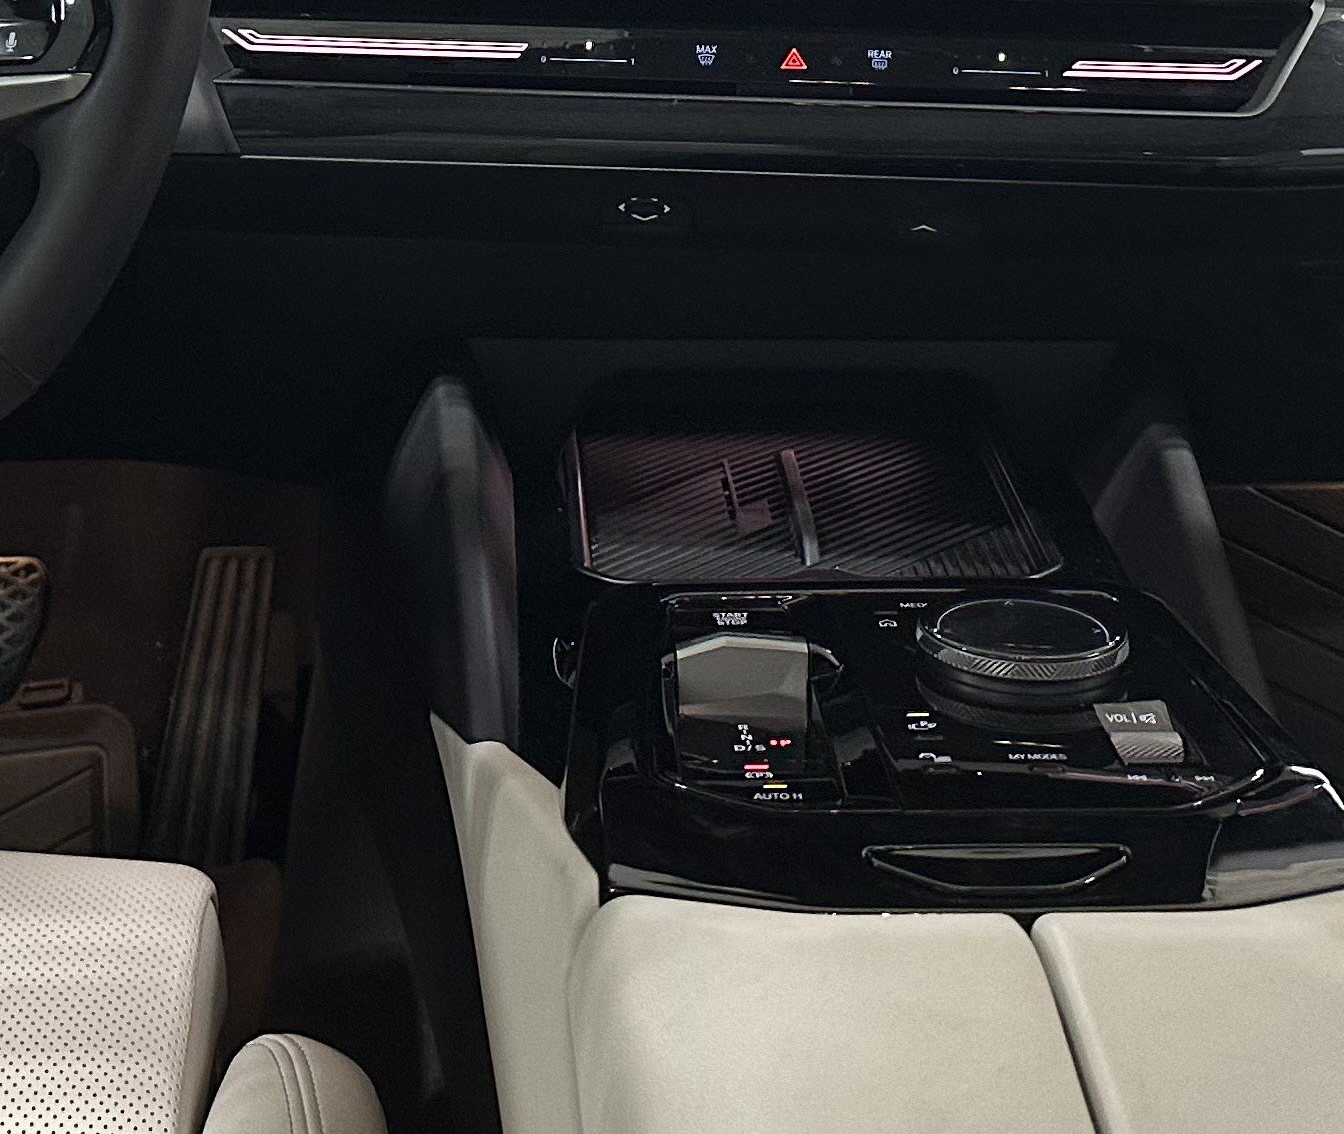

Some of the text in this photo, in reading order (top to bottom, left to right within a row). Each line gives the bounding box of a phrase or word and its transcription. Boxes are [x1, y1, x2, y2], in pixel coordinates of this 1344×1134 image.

[695, 44, 718, 54] MAX
[867, 49, 893, 60] REAR
[1106, 712, 1130, 724] VOL
[753, 792, 791, 801] AUTO
